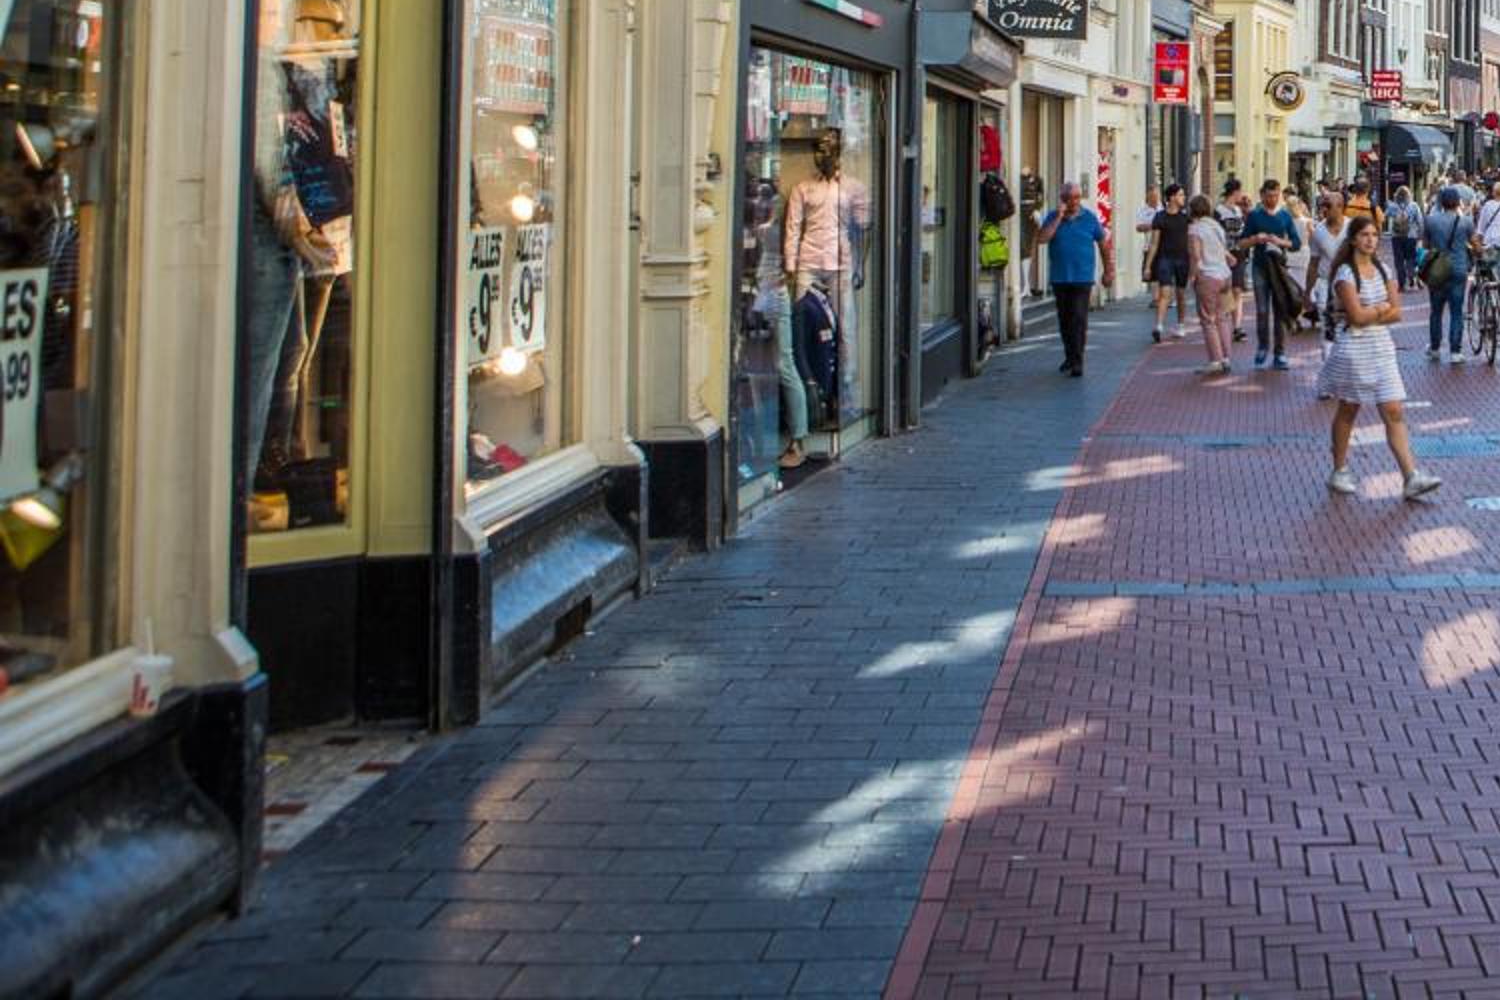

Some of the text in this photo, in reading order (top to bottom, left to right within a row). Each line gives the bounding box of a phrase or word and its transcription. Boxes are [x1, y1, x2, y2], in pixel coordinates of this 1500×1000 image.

[1000, 11, 1074, 31] Omnia
[470, 232, 503, 270] ALLES
[515, 228, 543, 264] ALLES
[0, 279, 37, 340] ES
